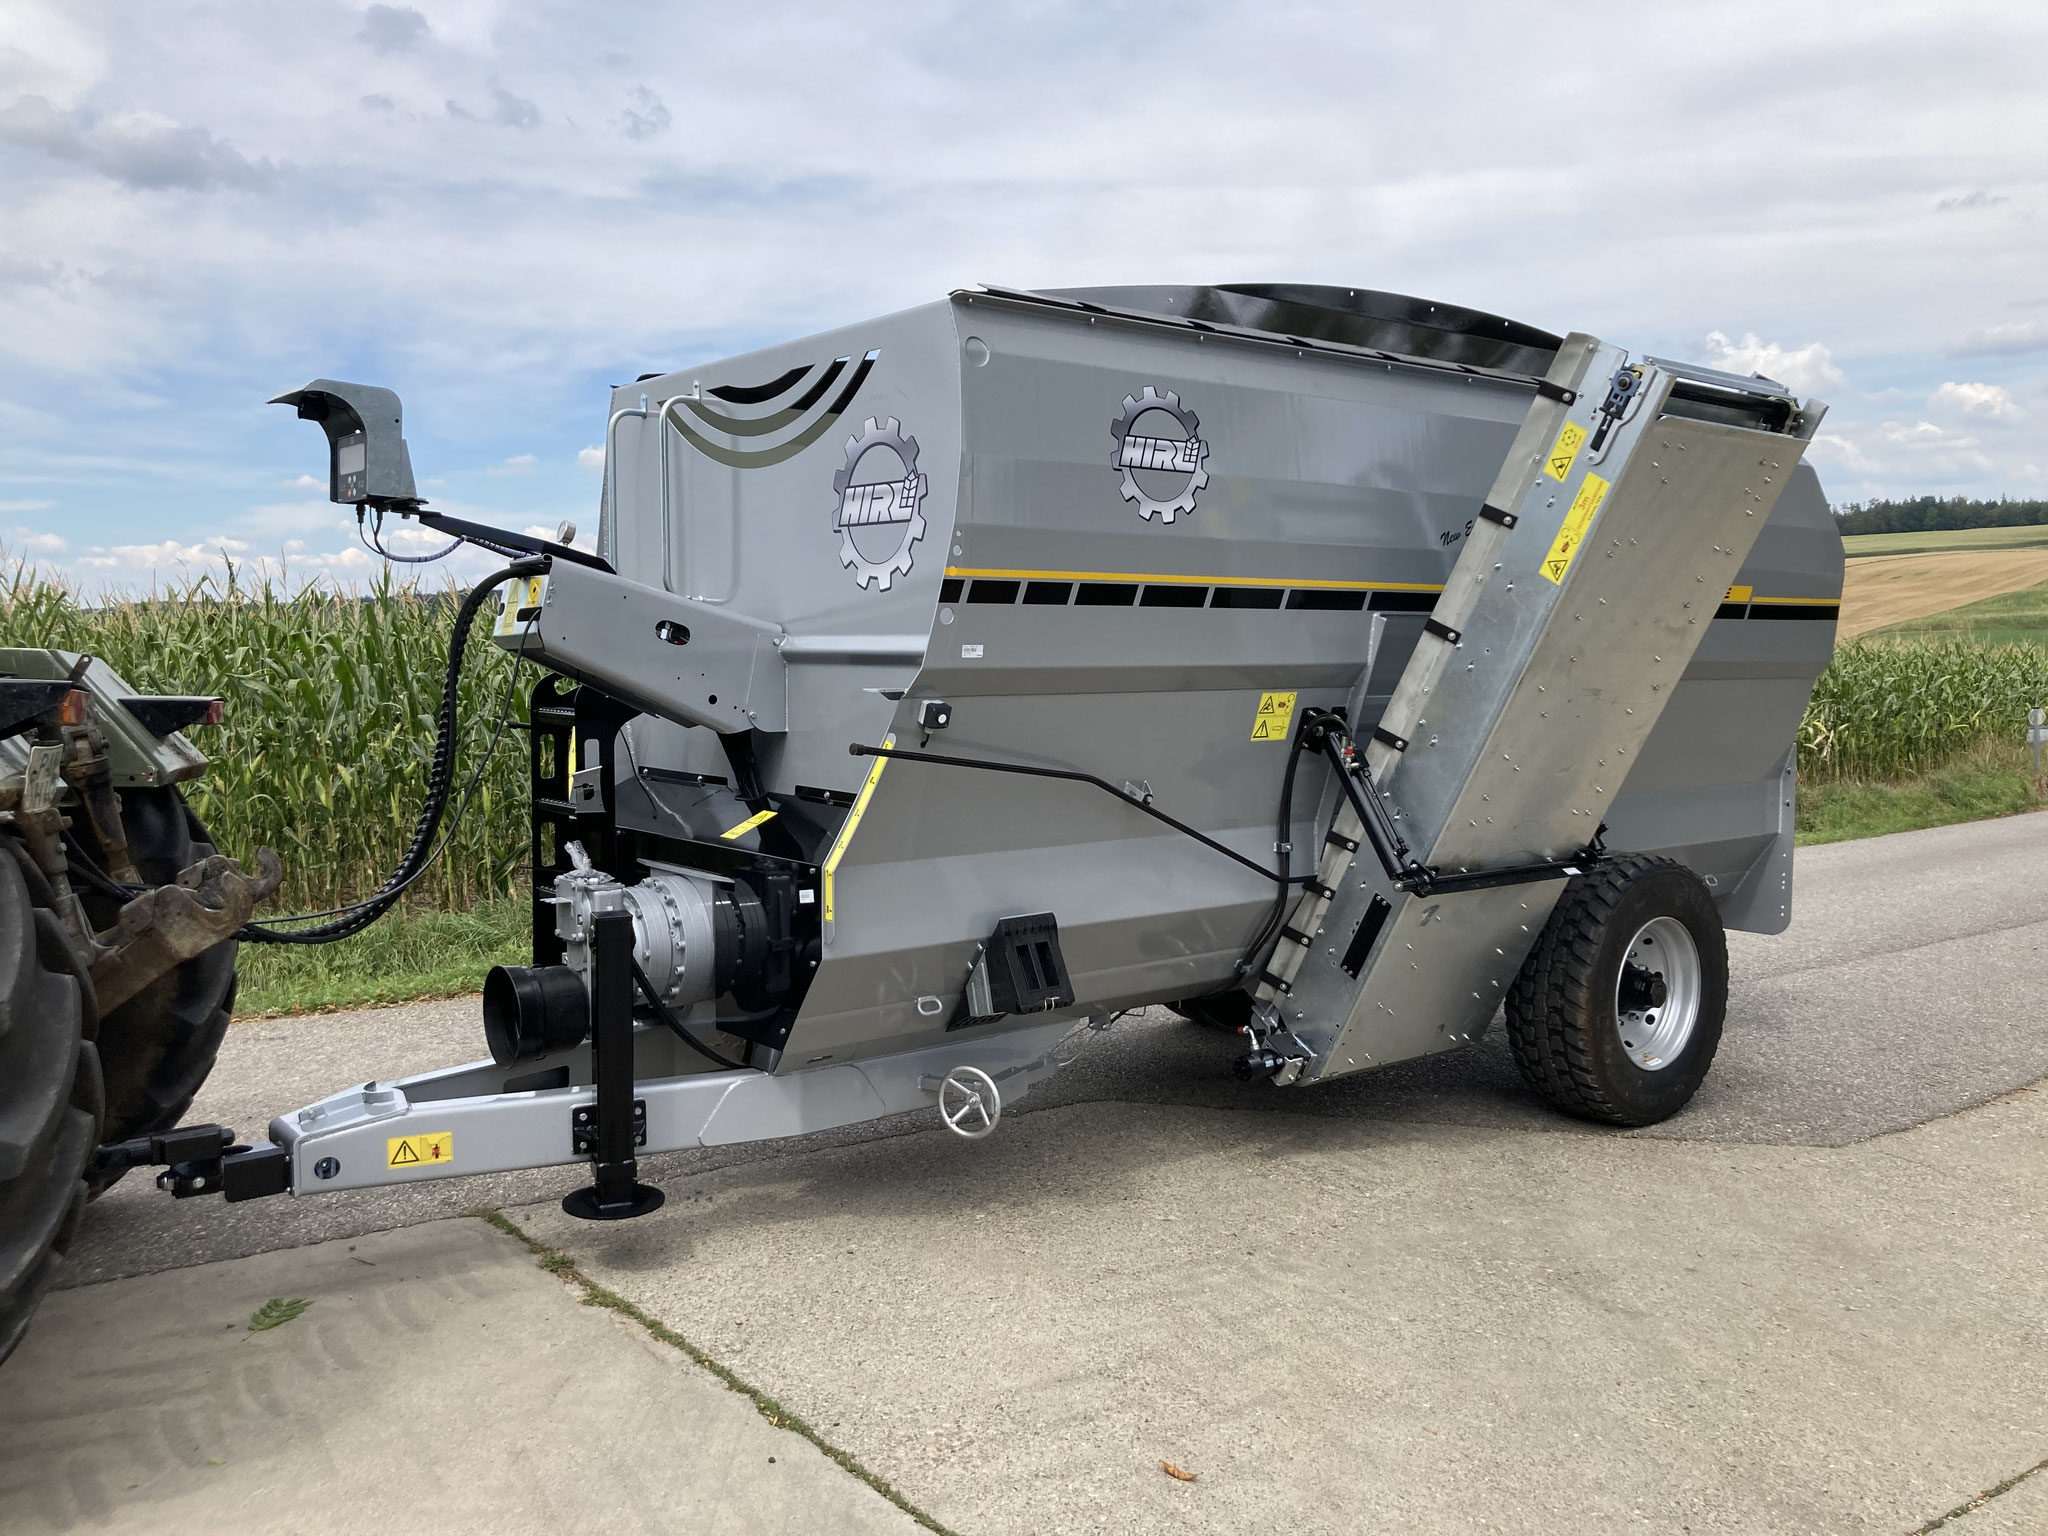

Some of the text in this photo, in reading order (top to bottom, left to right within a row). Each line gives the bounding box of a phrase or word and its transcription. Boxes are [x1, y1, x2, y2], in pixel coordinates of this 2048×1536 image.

[1119, 436, 1200, 473] HIRL
[839, 475, 919, 527] HIRL
[1440, 530, 1461, 547] New
